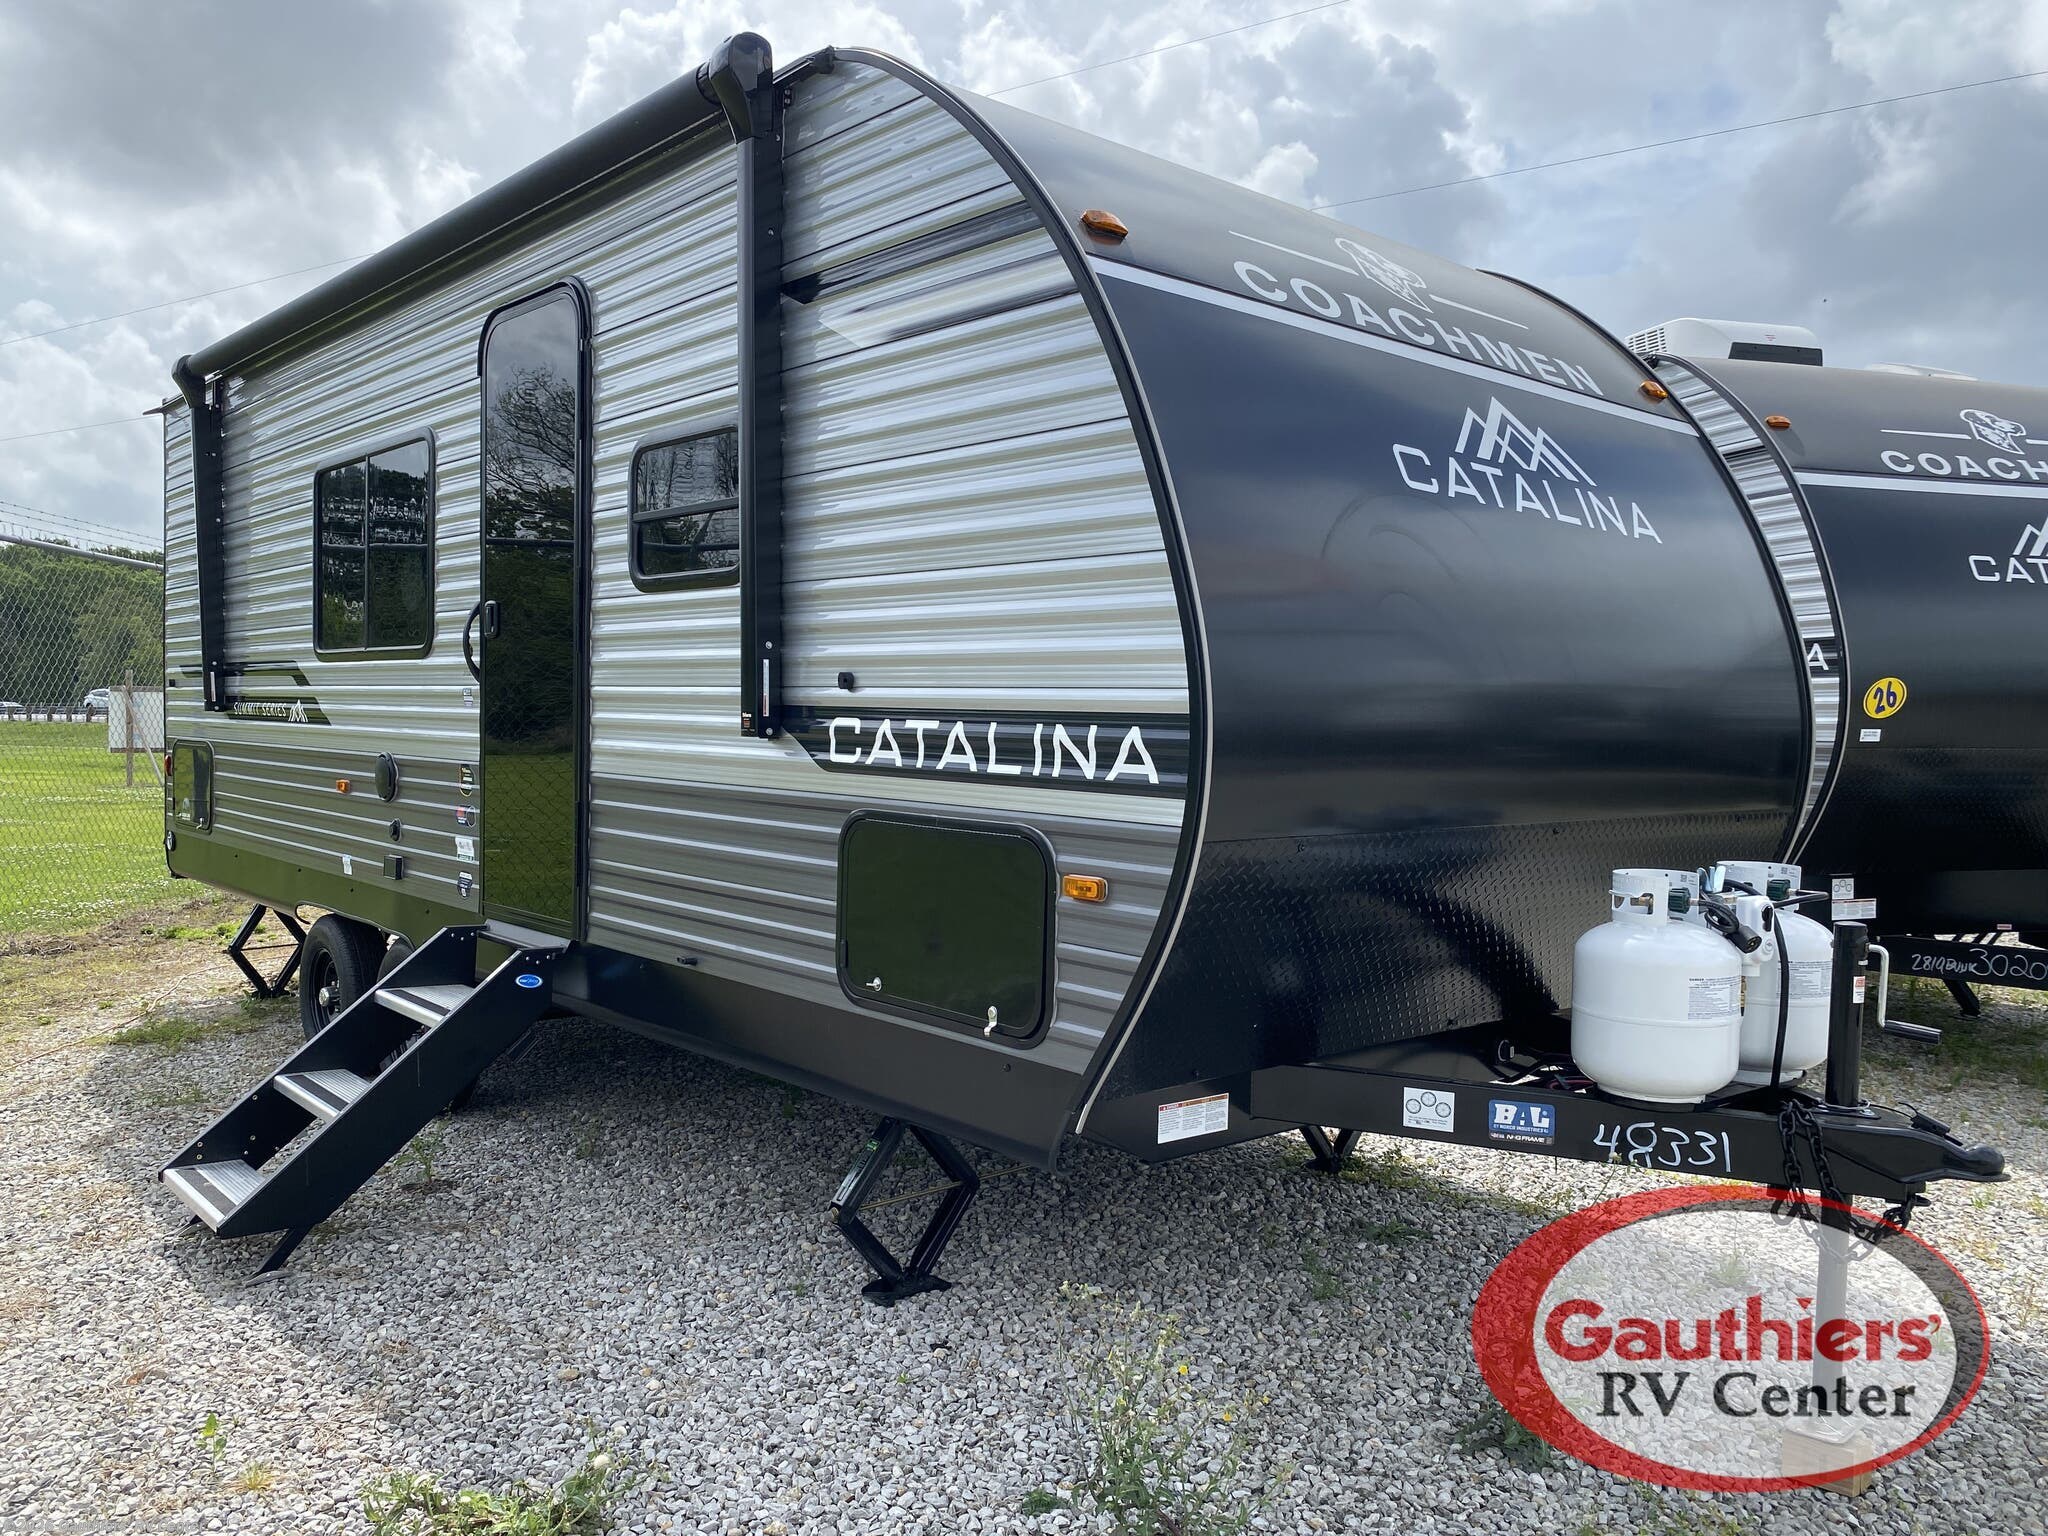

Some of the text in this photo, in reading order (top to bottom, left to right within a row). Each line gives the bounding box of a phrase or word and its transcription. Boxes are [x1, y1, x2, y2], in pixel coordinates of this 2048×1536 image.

[1233, 260, 1604, 396] COACHMEN
[1392, 443, 1663, 544] CATALINA
[233, 701, 287, 717] SUMMIT SERIES
[1873, 680, 1898, 714] 26
[828, 716, 1160, 785] CATALINA
[1494, 1103, 1550, 1128] BAL
[1593, 1121, 1732, 1172] 48331
